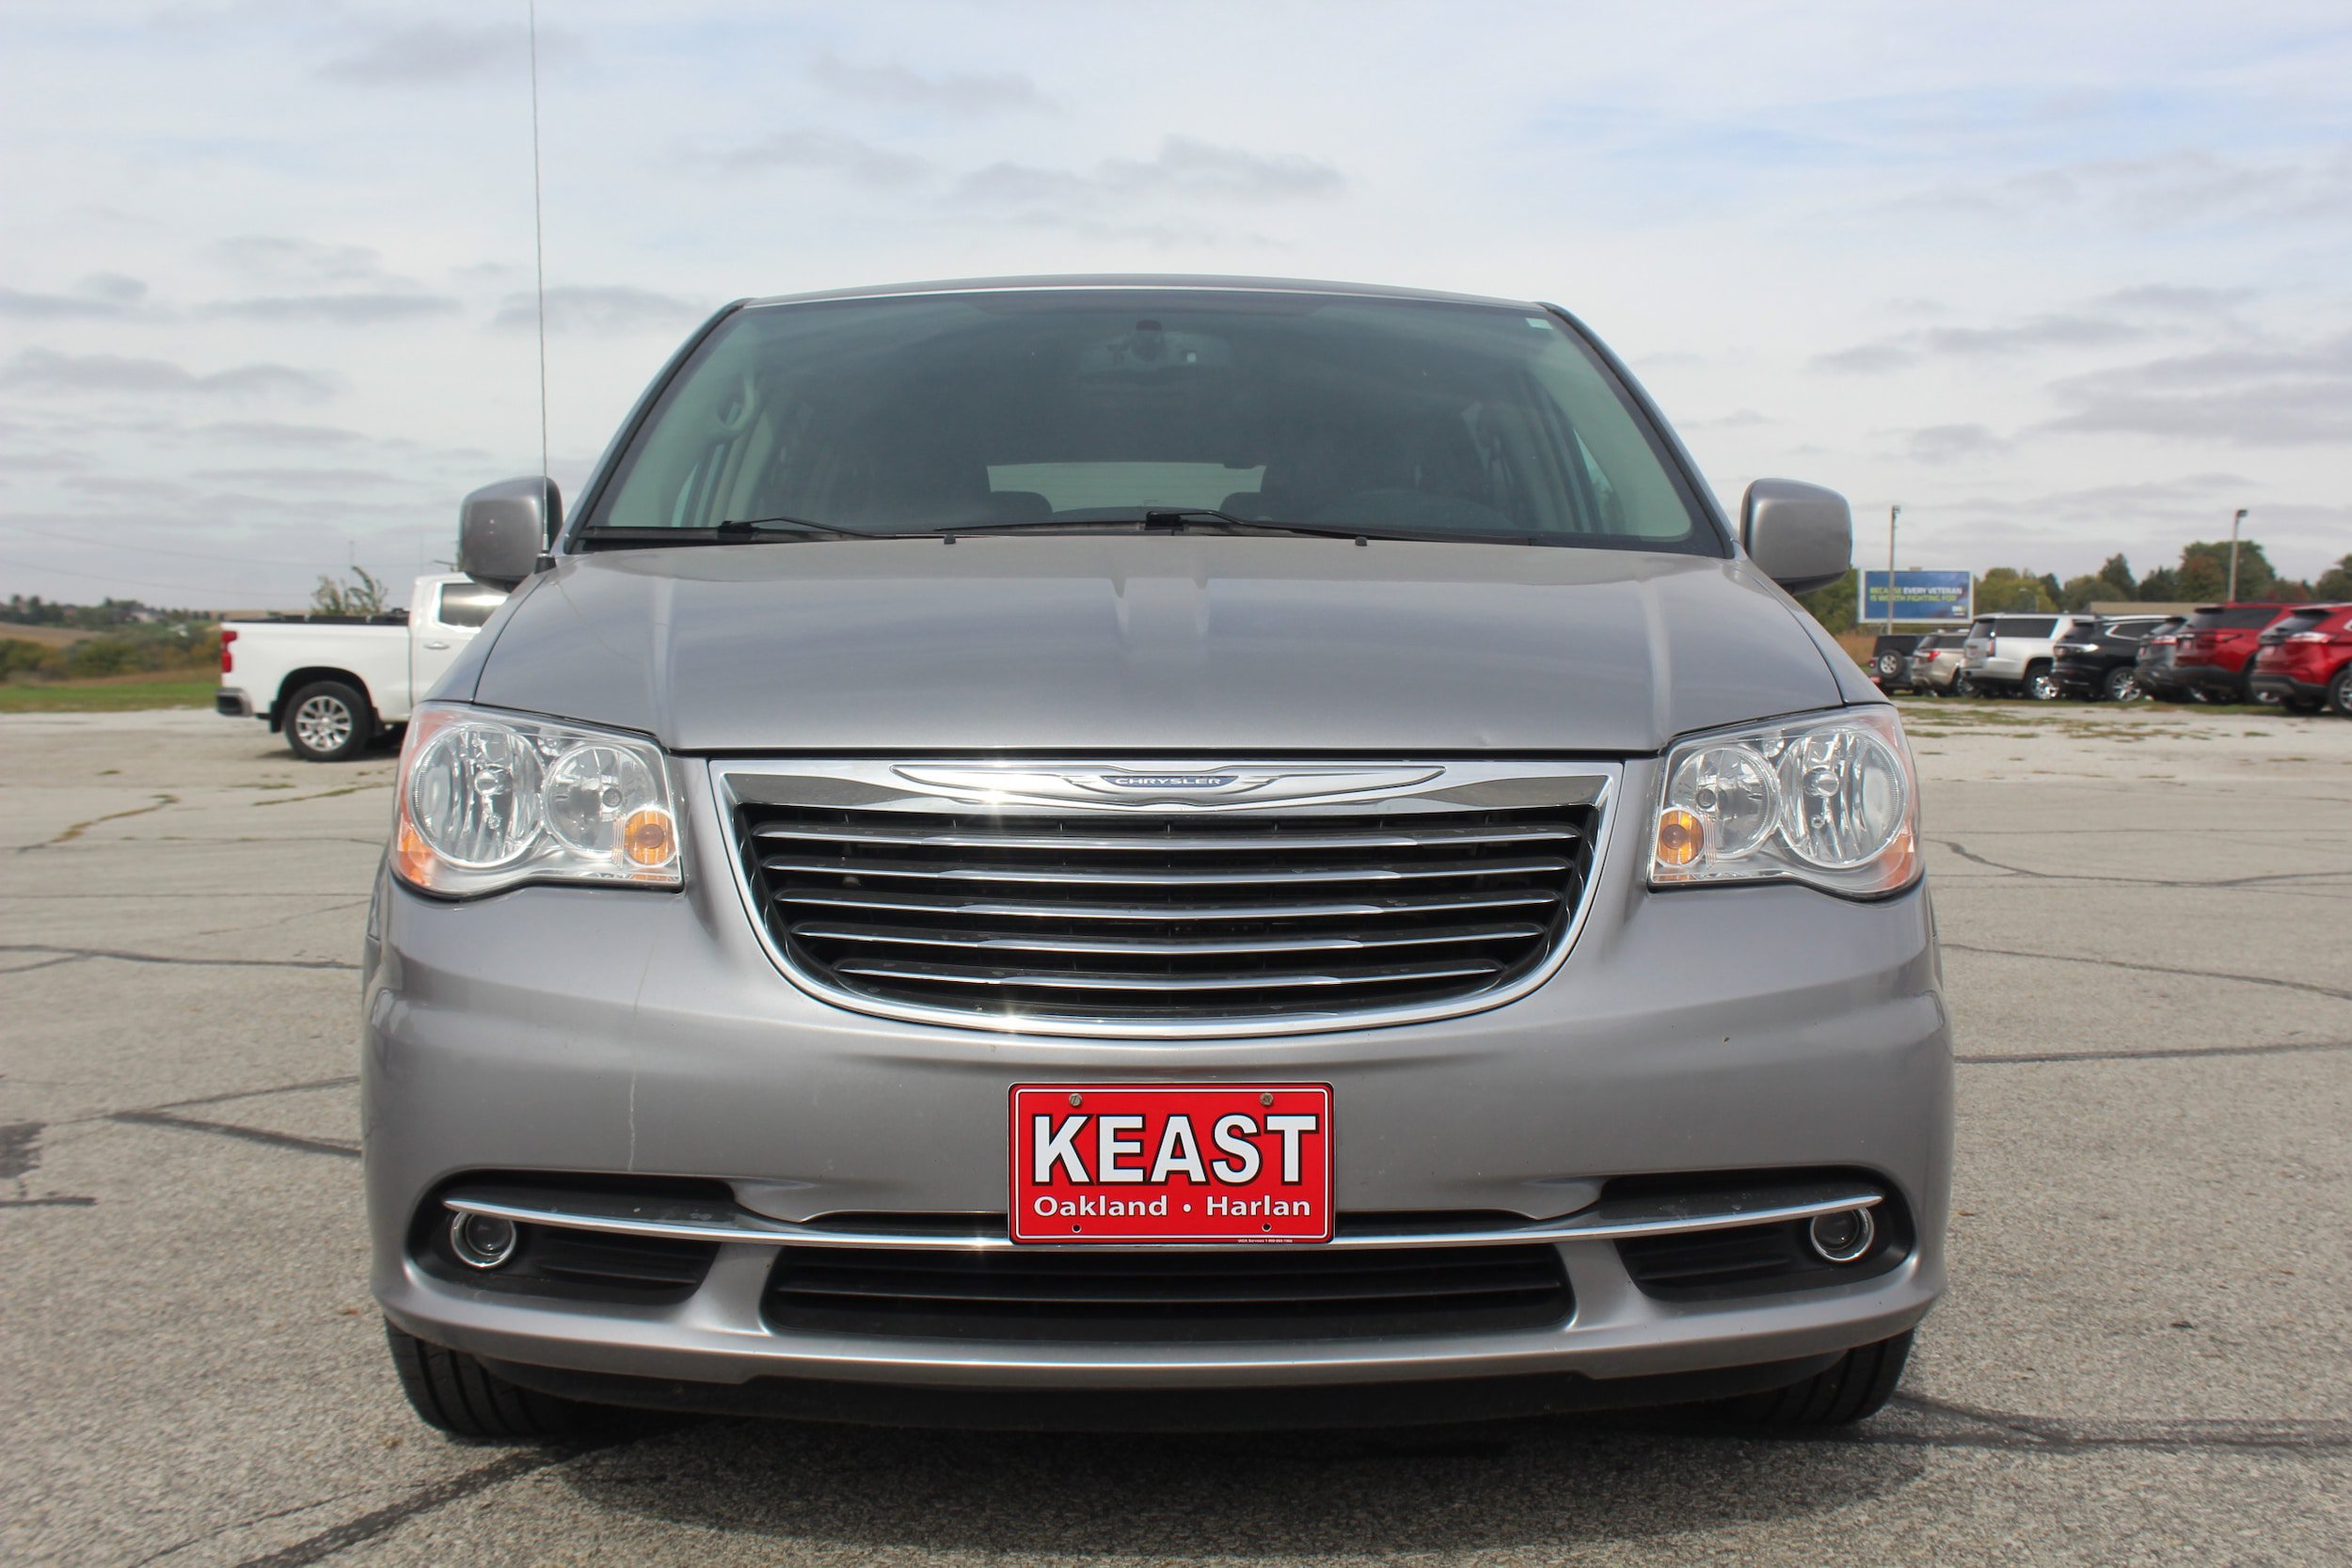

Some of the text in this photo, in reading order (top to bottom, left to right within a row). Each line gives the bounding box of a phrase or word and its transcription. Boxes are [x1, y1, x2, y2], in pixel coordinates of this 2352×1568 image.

[1032, 1114, 1319, 1185] KEAST
[1033, 1196, 1311, 1216] Oakland Harlan
